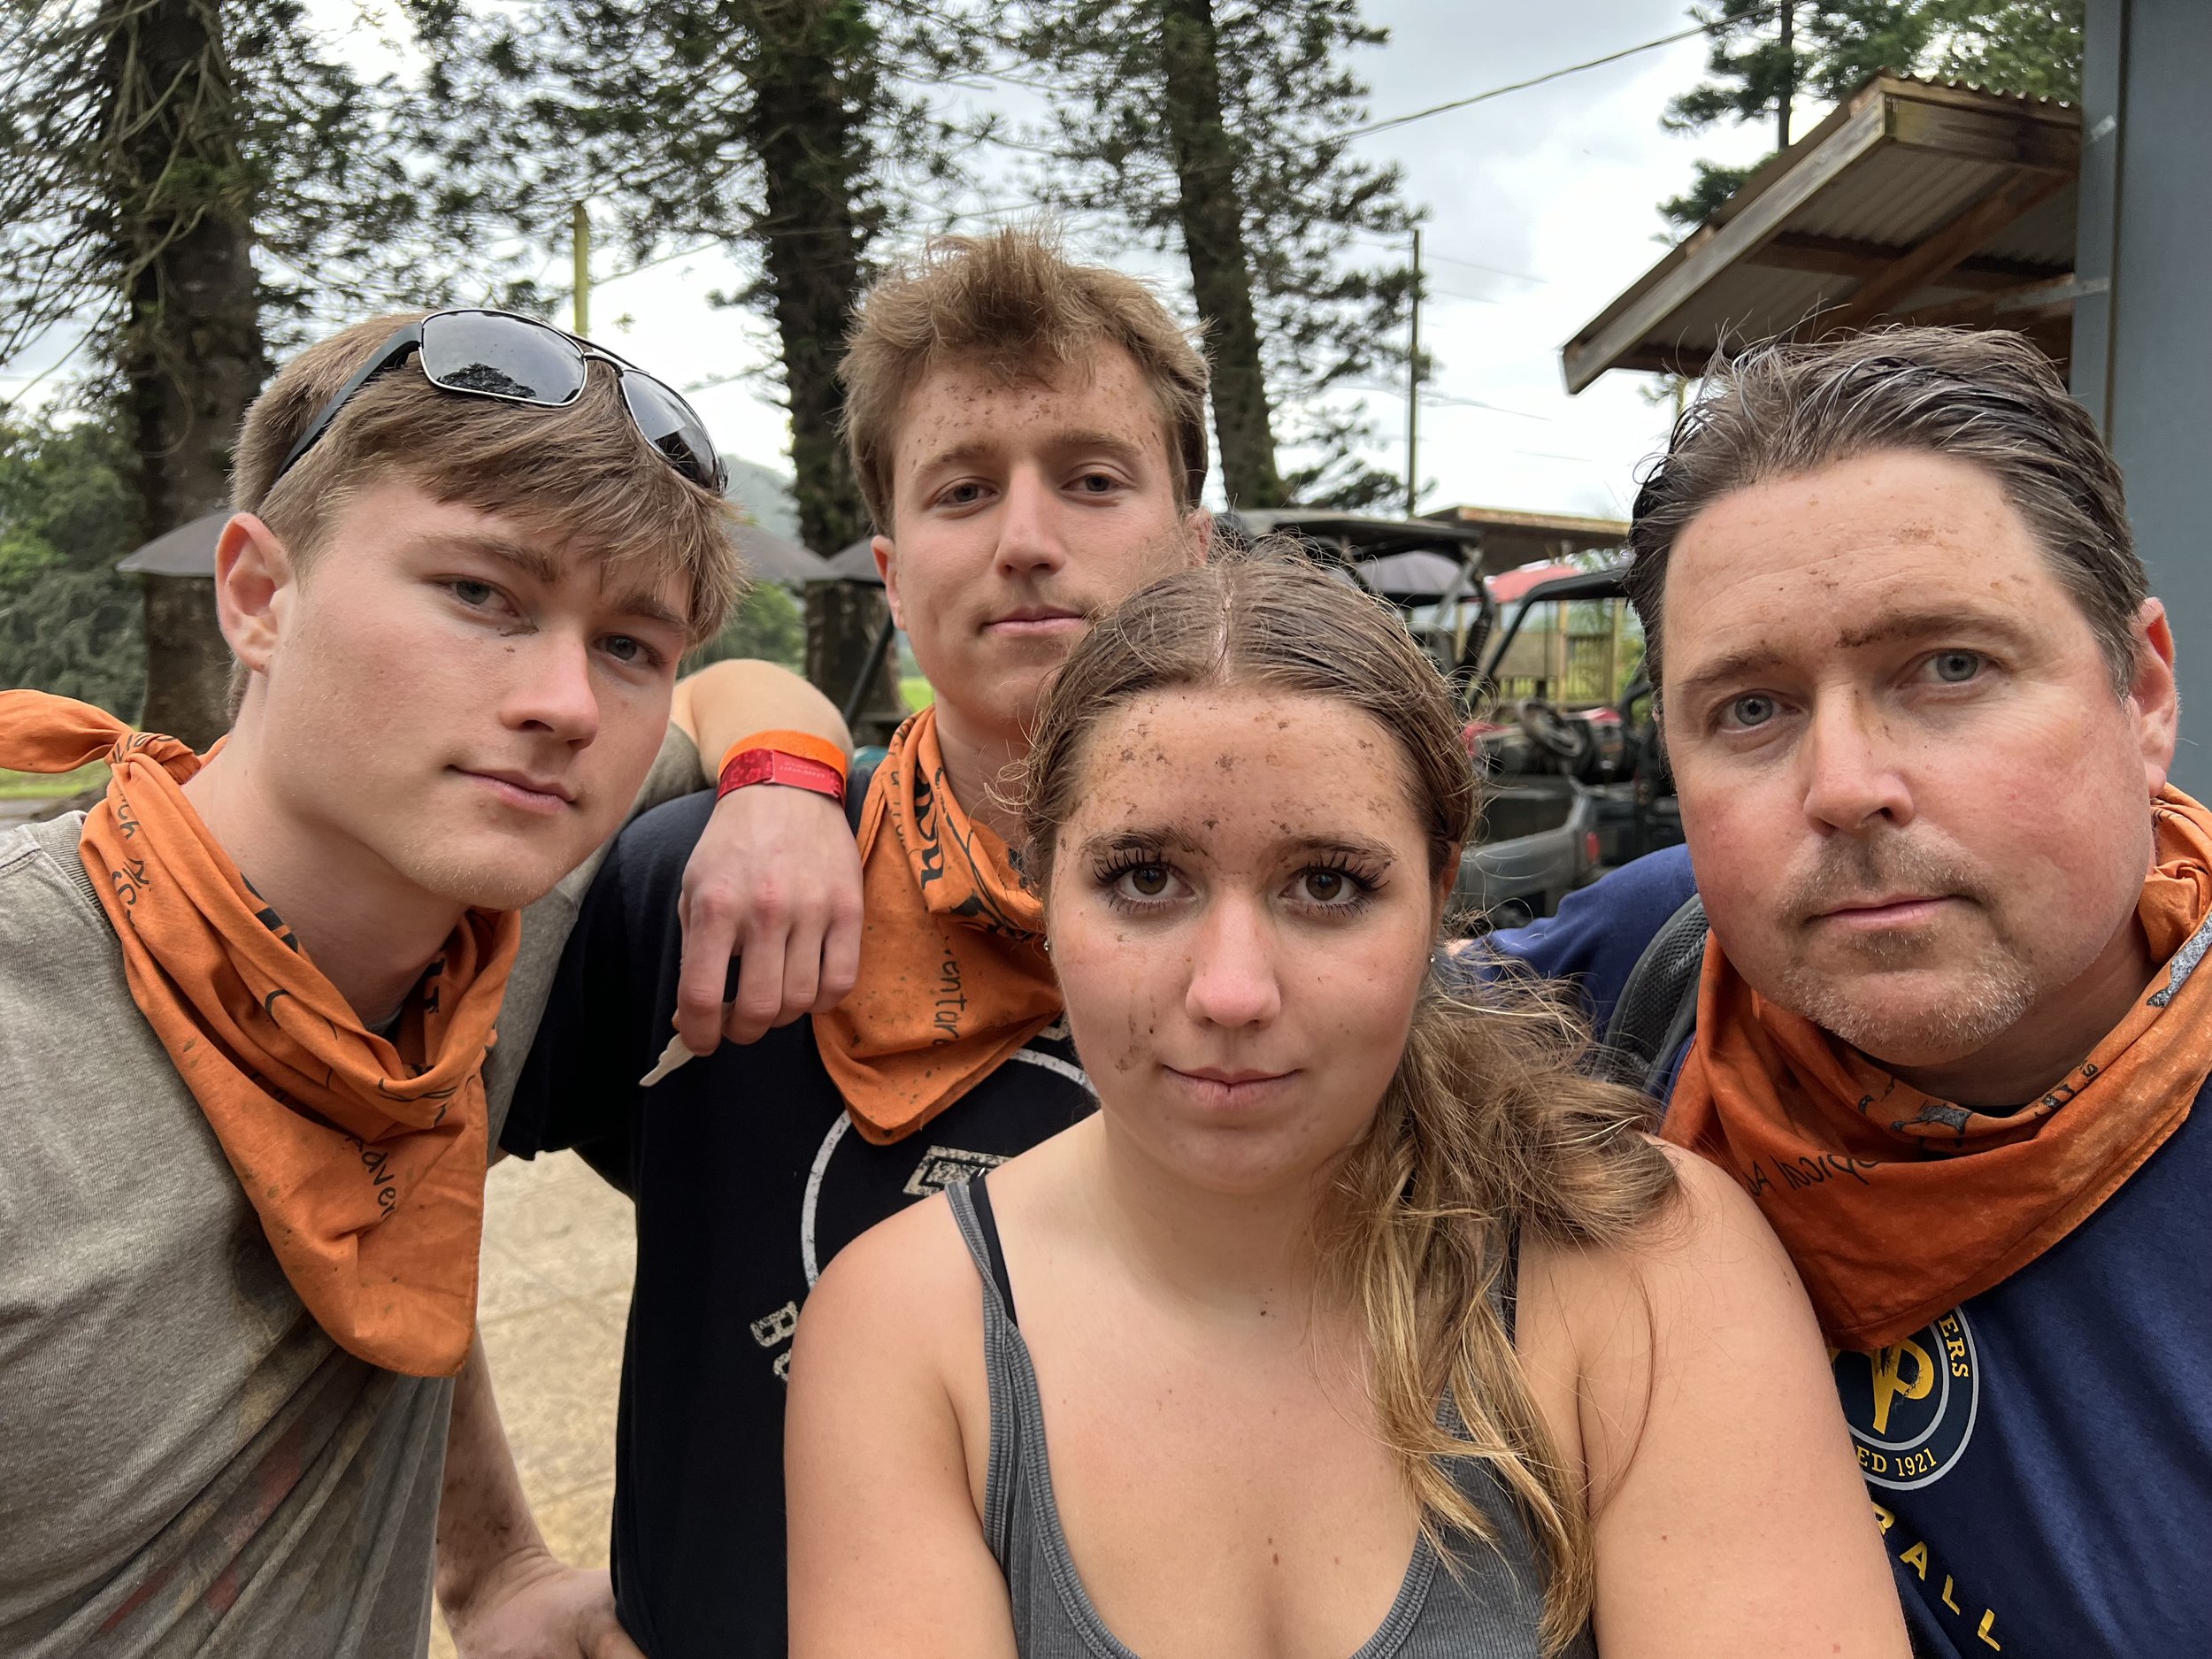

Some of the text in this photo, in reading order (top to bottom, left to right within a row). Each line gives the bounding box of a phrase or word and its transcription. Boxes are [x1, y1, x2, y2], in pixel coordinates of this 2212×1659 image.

[1939, 1315, 1969, 1378] ERS
[1856, 1445, 1937, 1477] ED 1921
